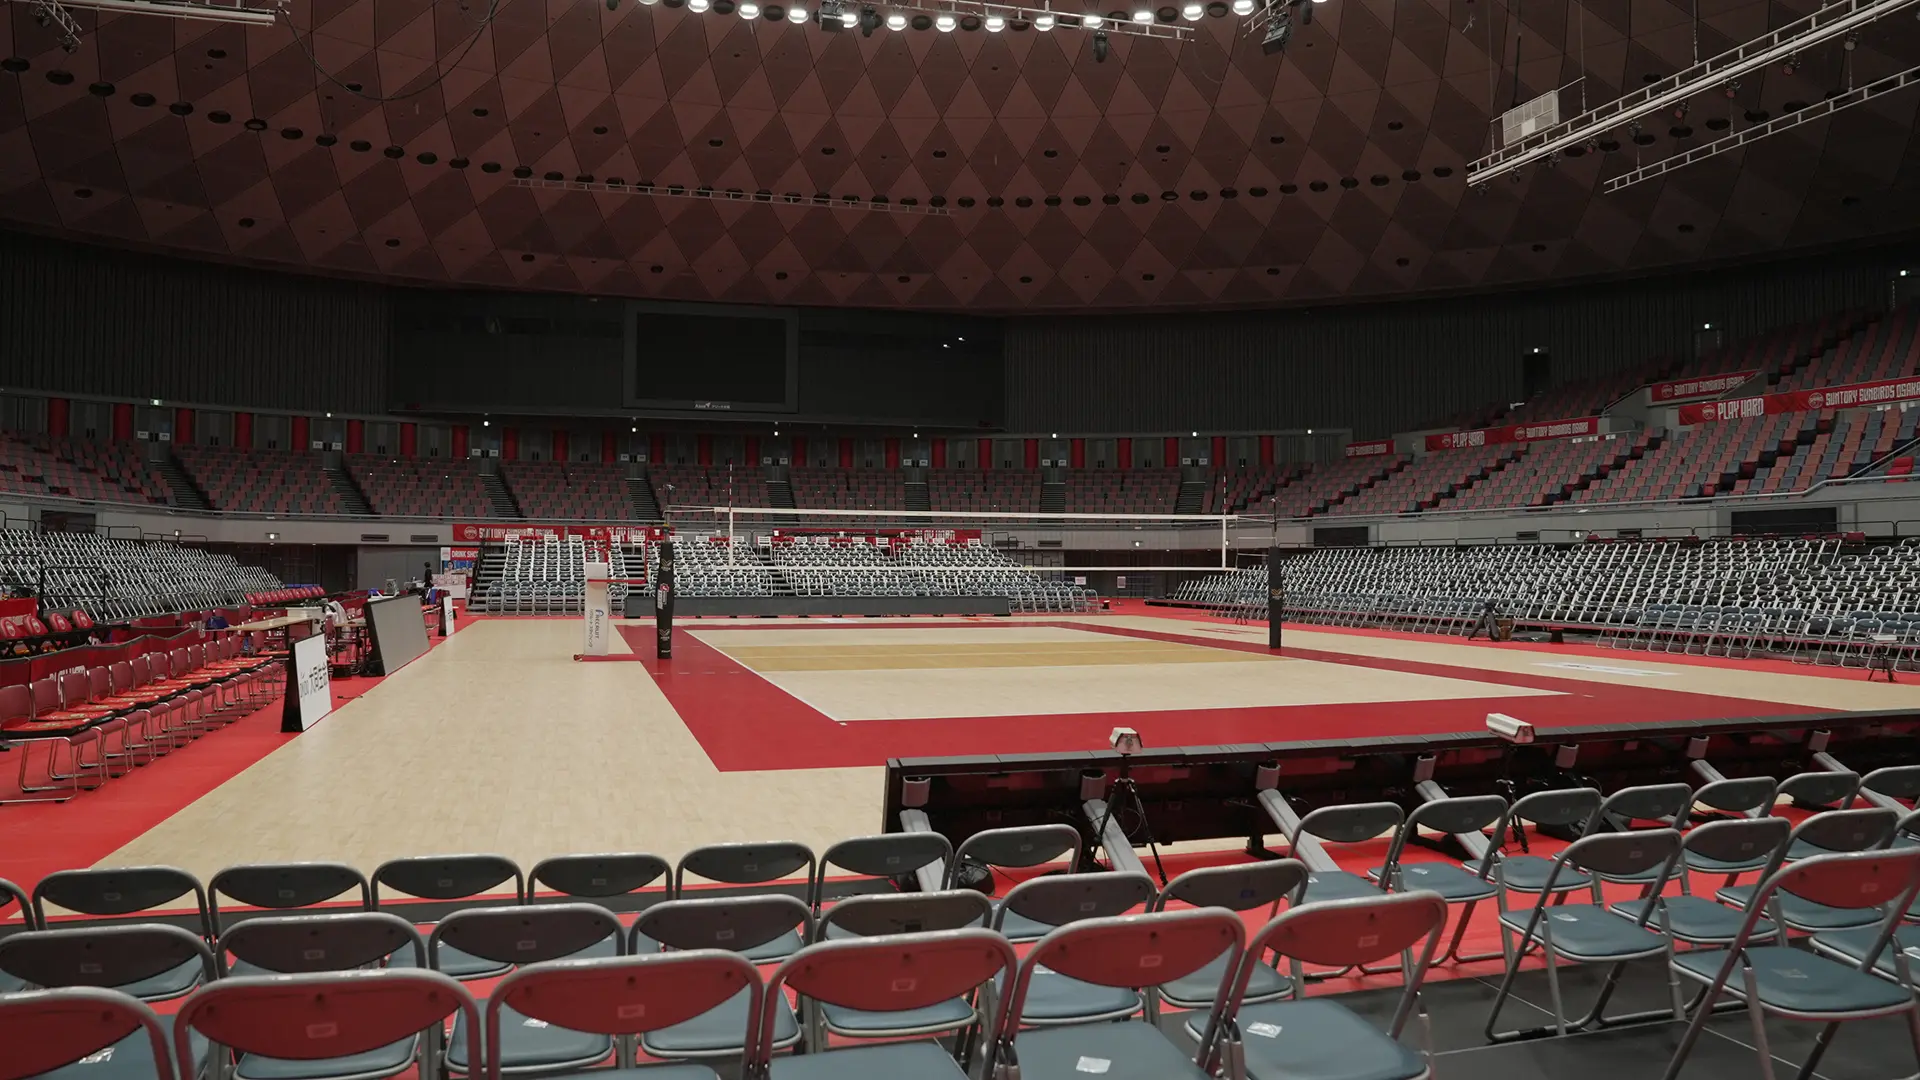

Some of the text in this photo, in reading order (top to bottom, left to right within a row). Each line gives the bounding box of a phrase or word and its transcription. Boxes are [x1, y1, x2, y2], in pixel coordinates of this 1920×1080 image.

[1825, 382, 1920, 406] SUNTORY SUNBIRDS OSAKA
[1717, 398, 1764, 420] PLAY HARD
[1453, 432, 1468, 447] PLAY
